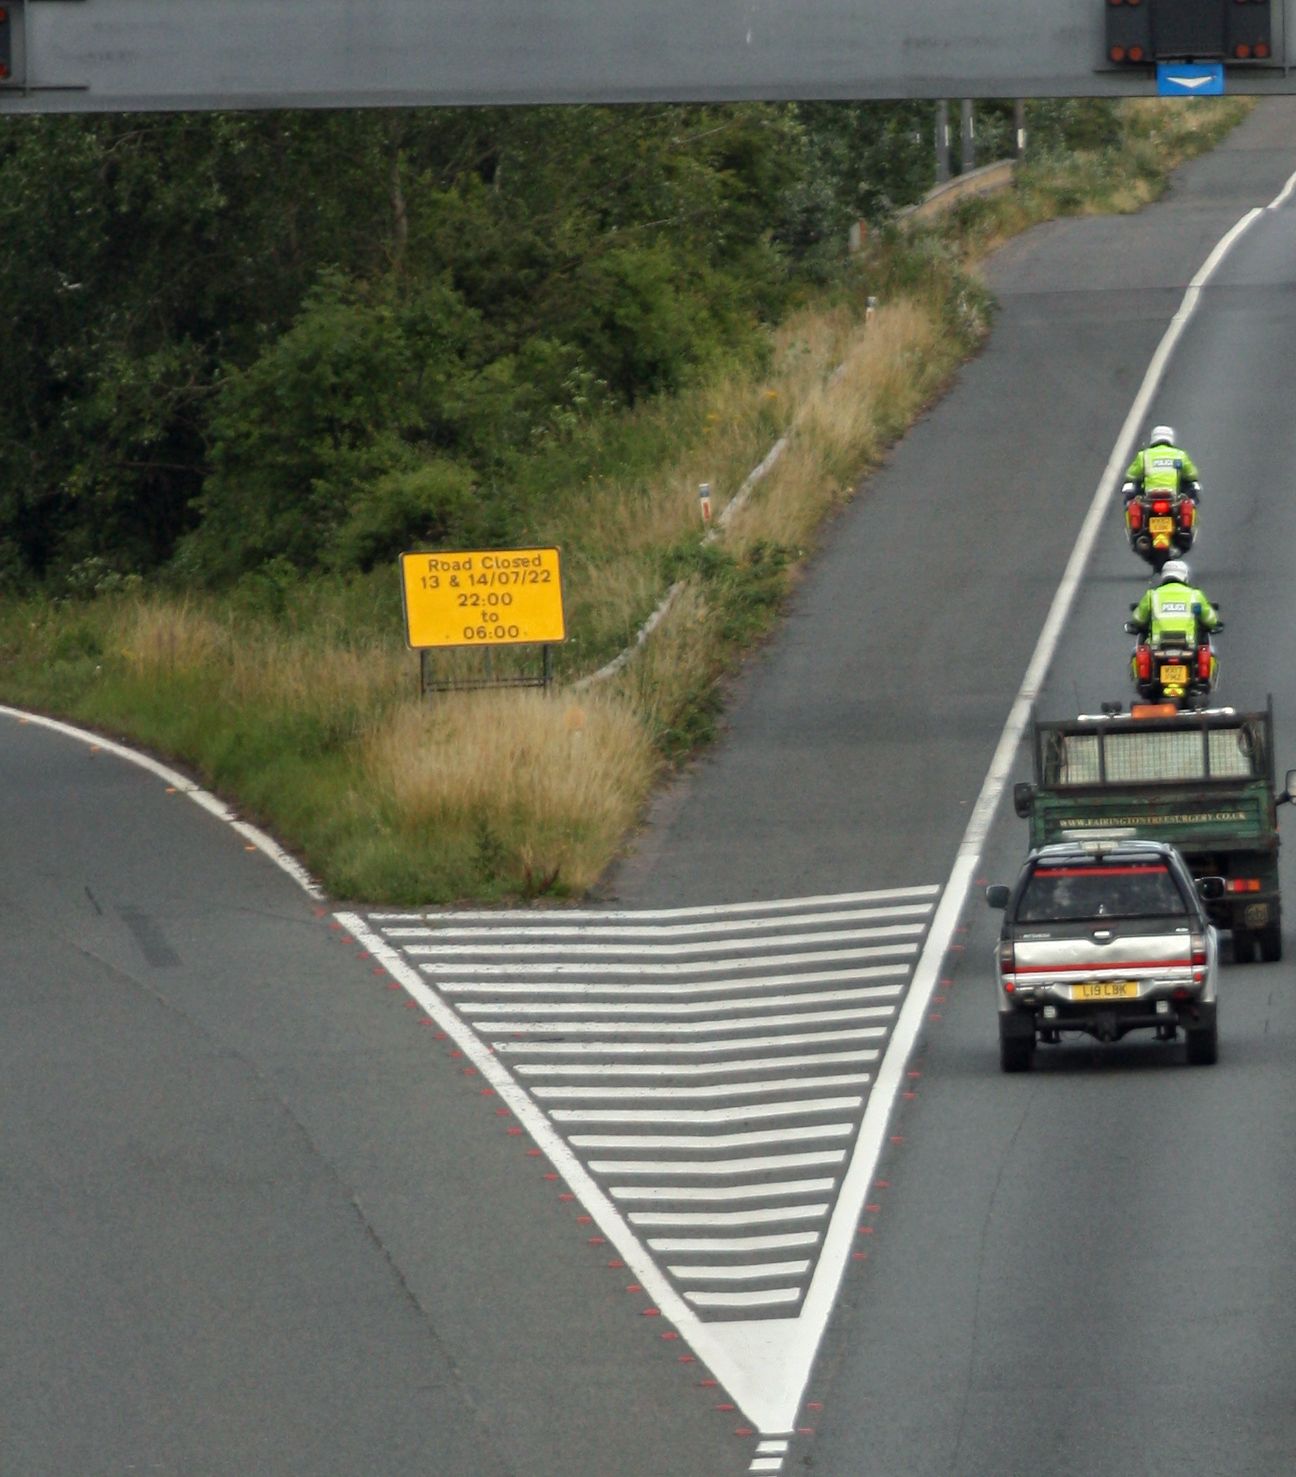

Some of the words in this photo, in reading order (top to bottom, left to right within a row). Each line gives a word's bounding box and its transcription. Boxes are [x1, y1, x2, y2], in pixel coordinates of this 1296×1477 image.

[428, 558, 473, 573] Road
[481, 554, 542, 570] Closed
[421, 575, 440, 590] 13
[449, 575, 461, 588] &
[469, 569, 551, 587] 14/07/22
[457, 592, 513, 607] 22:00
[481, 610, 499, 623] to
[463, 625, 519, 639] 06:00
[1082, 984, 1101, 996] L19
[1104, 983, 1127, 995] LBK
